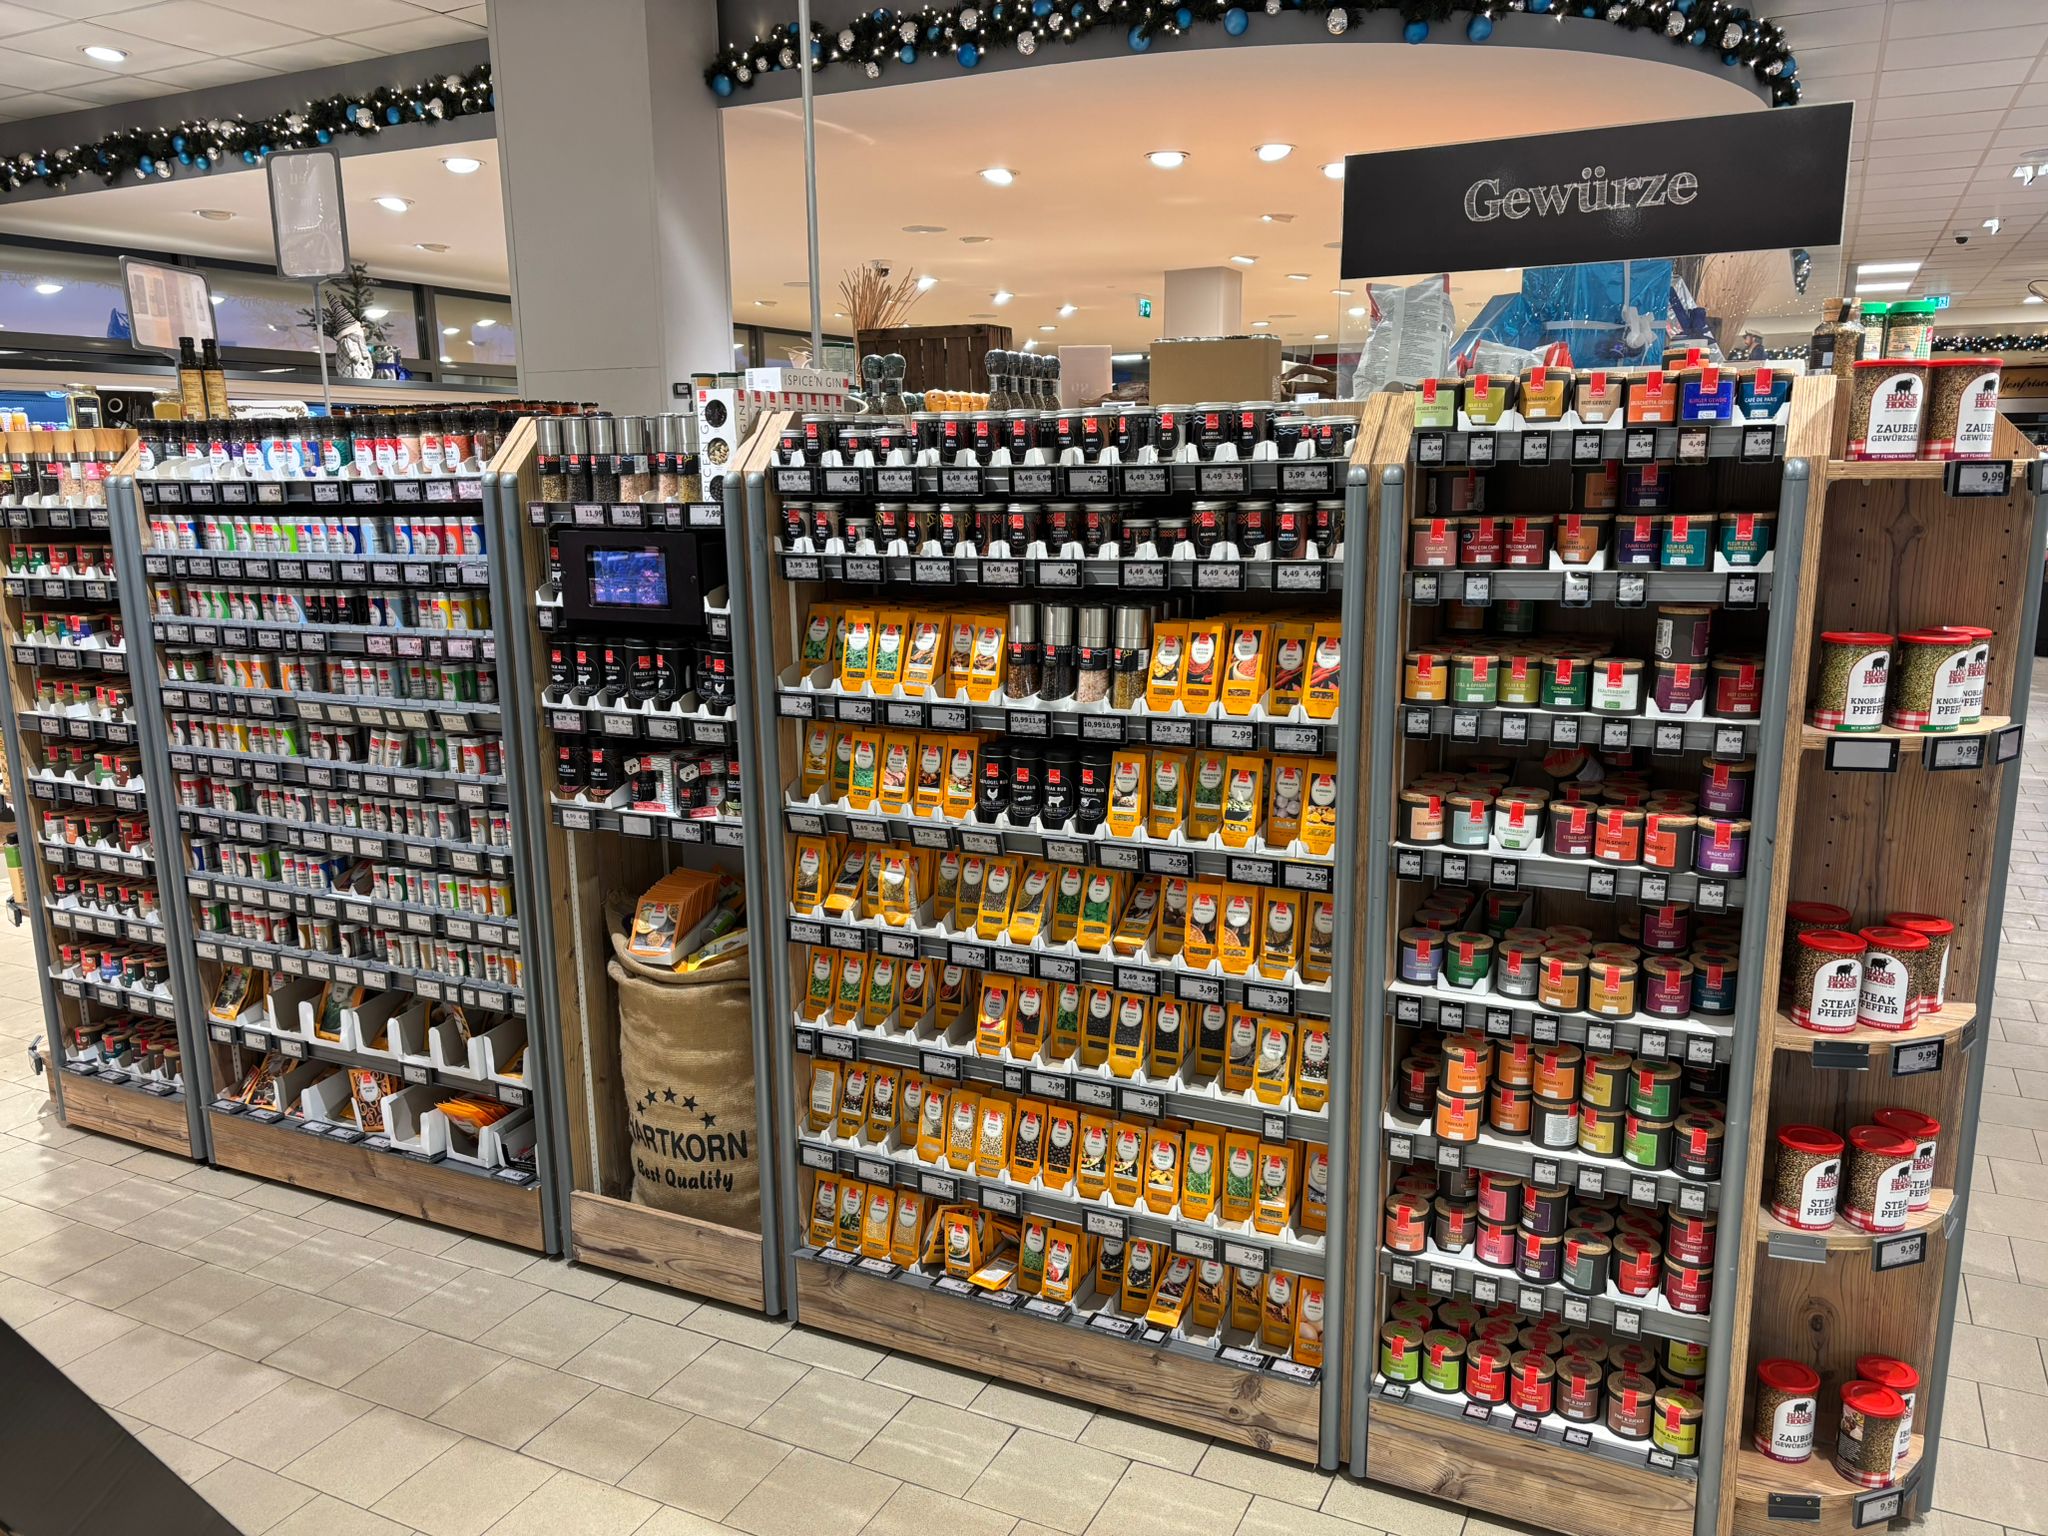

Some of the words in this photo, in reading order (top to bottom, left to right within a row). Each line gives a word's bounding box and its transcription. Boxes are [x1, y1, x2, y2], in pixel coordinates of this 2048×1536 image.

[1464, 166, 1699, 222] Gewürze
[826, 376, 842, 387] GIN
[1887, 394, 1918, 402] BLOCK
[1885, 400, 1917, 408] HOUSE
[1974, 400, 1997, 408] HOUS
[701, 406, 709, 434] GIN
[1876, 424, 1918, 433] ZAUBER
[843, 475, 858, 484] 4,49
[1088, 475, 1107, 484] 4,29
[1982, 471, 2004, 482] 9,99
[705, 510, 721, 518] 7,99
[1058, 568, 1076, 577] 4,49
[855, 706, 871, 714] 2,49
[904, 710, 921, 718] 2,59
[948, 712, 965, 721] 2,79
[1084, 721, 1102, 729] 10,99
[1232, 730, 1252, 740] 2,99
[1295, 734, 1316, 743] 2,99
[1957, 746, 1978, 756] 9,99
[685, 826, 700, 835] 6,99
[1119, 853, 1137, 863] 2,59
[1168, 858, 1188, 867] 2,59
[1236, 864, 1252, 872] 4,39
[1257, 865, 1273, 874] 2,79
[1306, 872, 1327, 882] 2,59
[898, 942, 914, 950] 2,99
[968, 951, 984, 961] 2,79
[1016, 956, 1030, 965] 2,99
[1057, 964, 1075, 974] 2,79
[1199, 984, 1218, 994] 3,99
[1268, 994, 1288, 1005] 3,39
[1859, 989, 1896, 1005] STEAK
[1821, 999, 1856, 1008] STEAK
[837, 1042, 851, 1051] 2,79
[1918, 1050, 1937, 1062] 9,99
[940, 1061, 956, 1071] 2,99
[1048, 1081, 1065, 1091] 2,99
[1093, 1089, 1111, 1099] 2,59
[1140, 1098, 1159, 1108] 3,69
[817, 1155, 832, 1164] 3,69
[637, 1157, 660, 1183] Best
[665, 1169, 733, 1192] Quality
[938, 1182, 953, 1192] 3,79
[1810, 1199, 1837, 1208] STEA
[1885, 1200, 1907, 1210] STEA
[1195, 1241, 1213, 1251] 2,89
[1901, 1243, 1920, 1254] 9,99
[1244, 1252, 1263, 1262] 2,99
[1111, 1321, 1130, 1330] 2,99
[1880, 1500, 1897, 1511] 9,99
